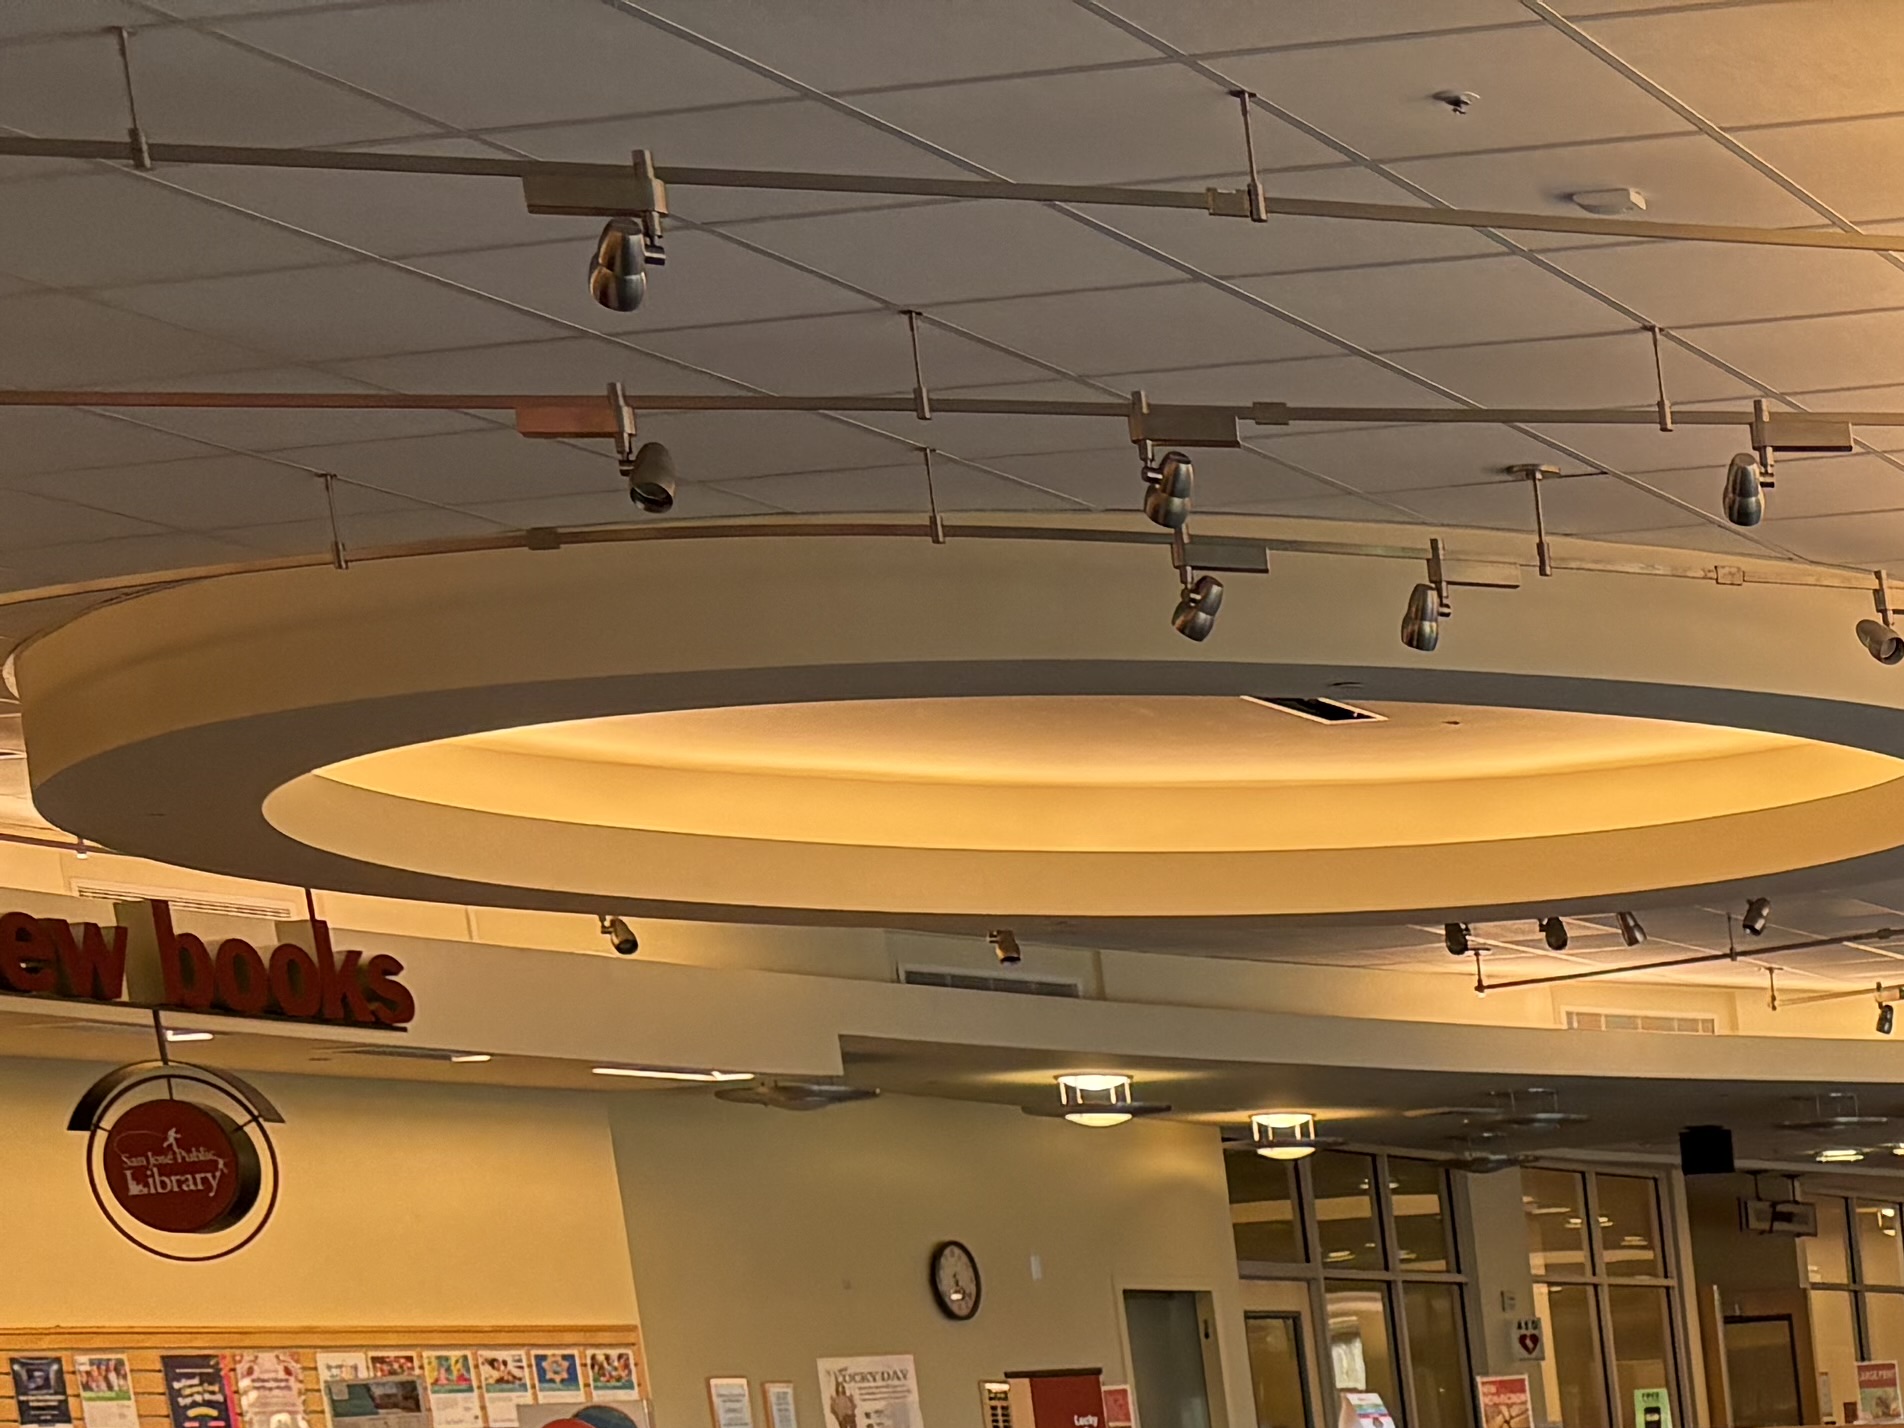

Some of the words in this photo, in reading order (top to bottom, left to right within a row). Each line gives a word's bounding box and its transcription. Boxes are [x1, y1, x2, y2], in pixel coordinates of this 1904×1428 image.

[0, 911, 128, 1001] ew
[151, 899, 416, 1024] books
[122, 1154, 146, 1167] San
[177, 1147, 216, 1162] Public
[123, 1167, 221, 1197] Library
[881, 1369, 909, 1382] DAY
[1074, 1414, 1098, 1427] Lucky
